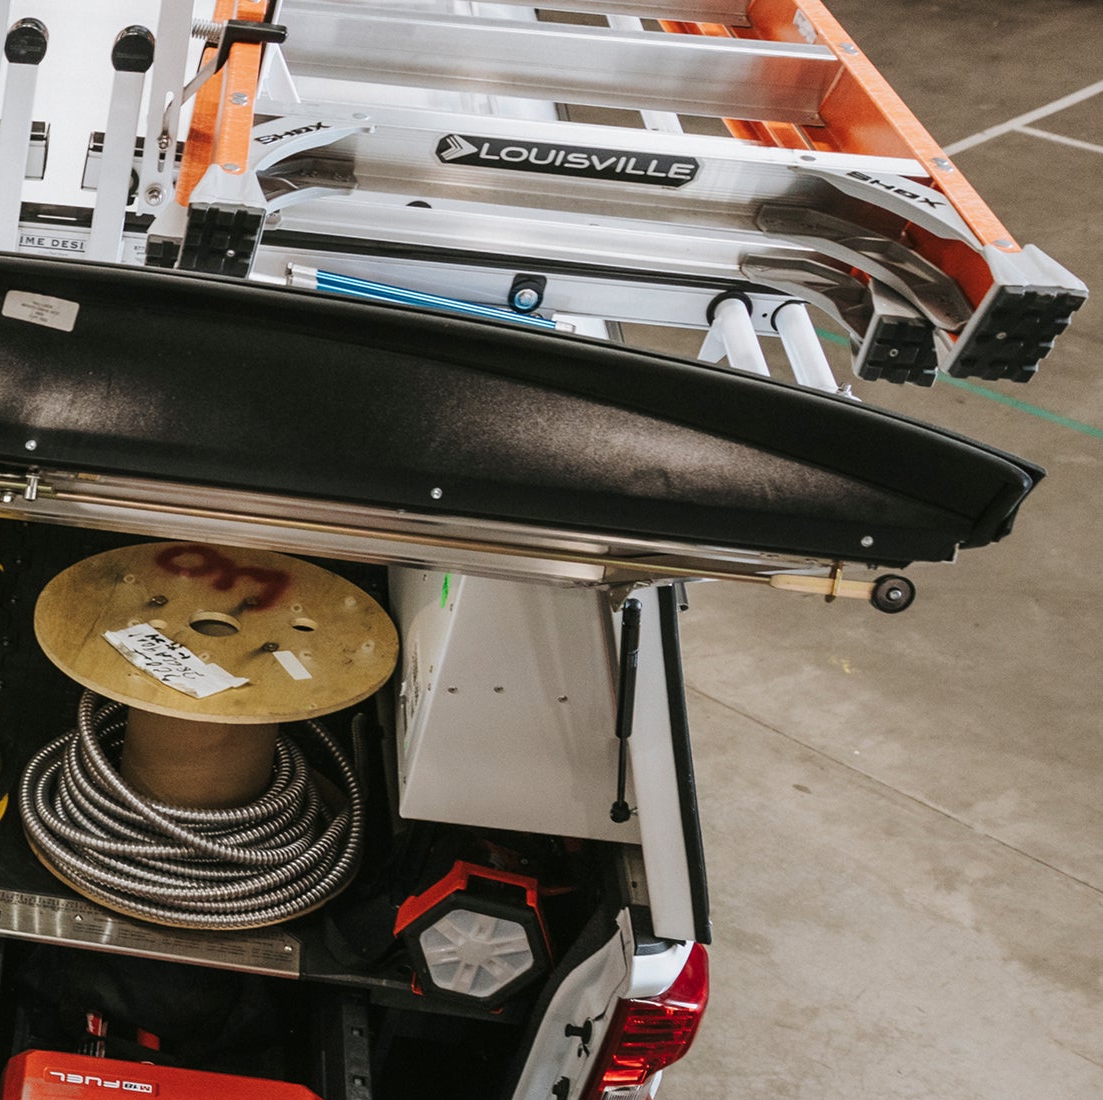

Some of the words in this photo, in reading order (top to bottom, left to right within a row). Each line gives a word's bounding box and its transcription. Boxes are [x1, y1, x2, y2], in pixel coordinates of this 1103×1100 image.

[479, 142, 696, 180] LOUISVILLE
[19, 235, 45, 246] IME
[51, 238, 84, 250] DESI
[49, 1070, 121, 1090] FUEL
[123, 1082, 152, 1093] M18
